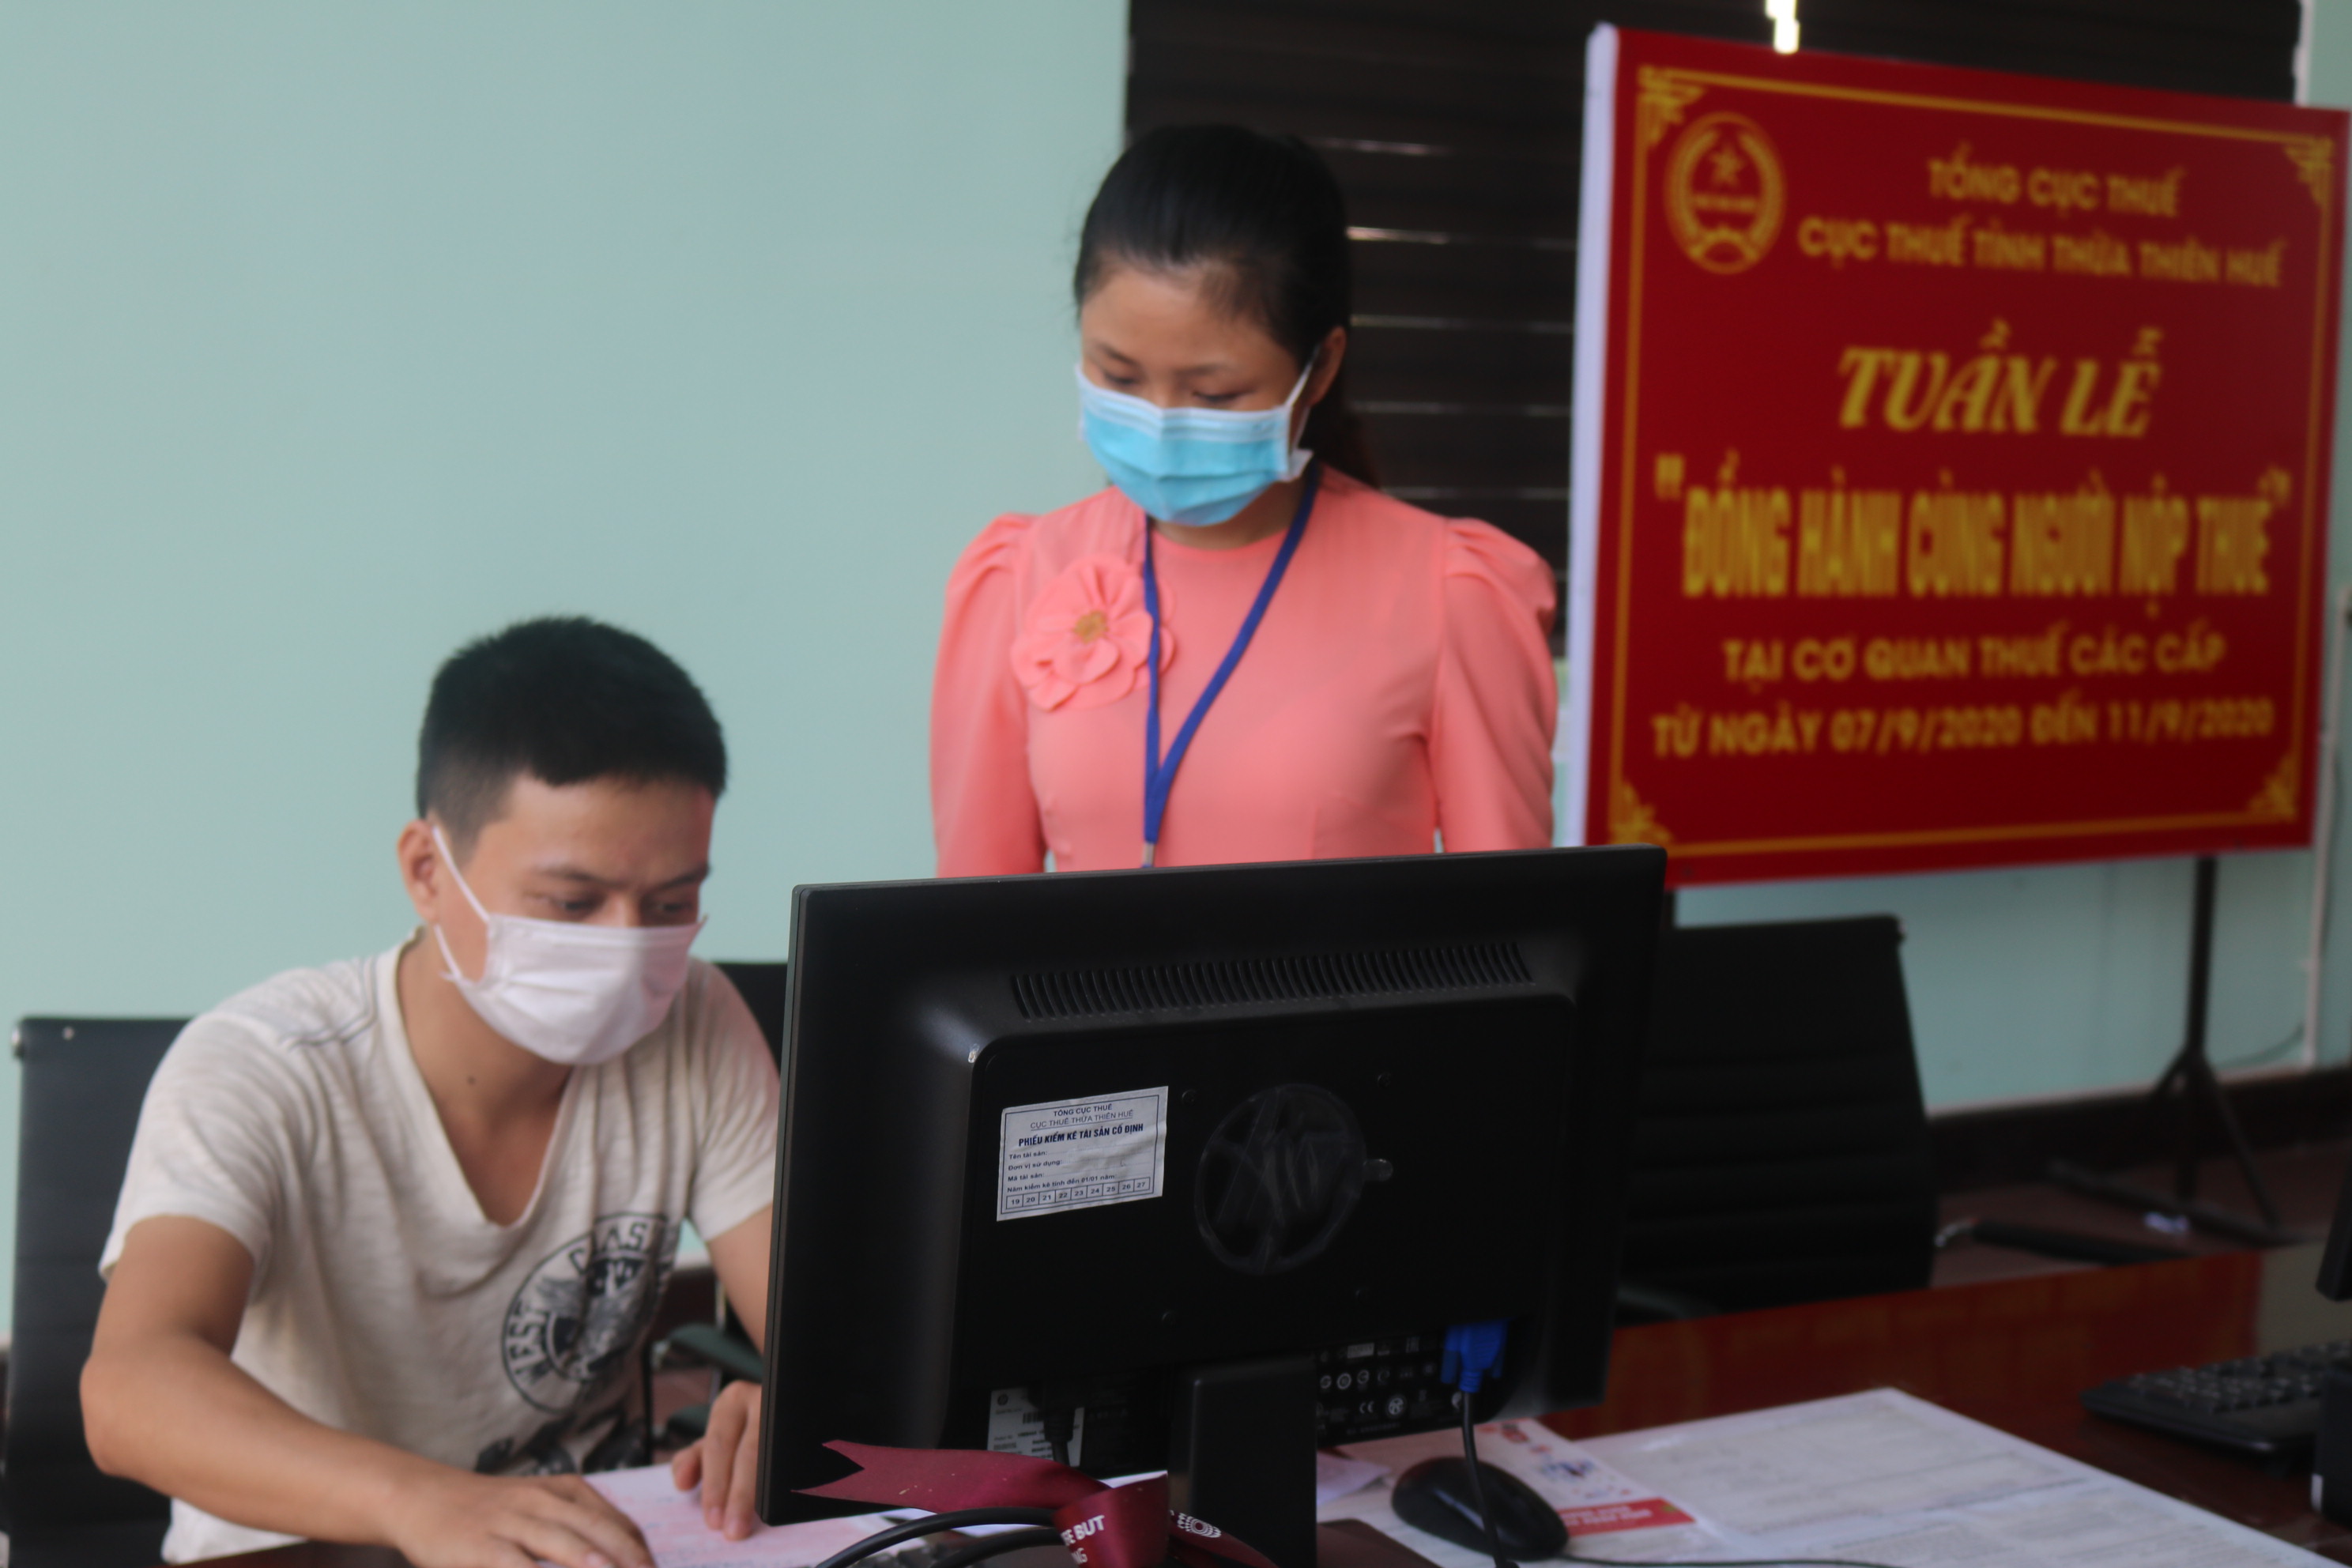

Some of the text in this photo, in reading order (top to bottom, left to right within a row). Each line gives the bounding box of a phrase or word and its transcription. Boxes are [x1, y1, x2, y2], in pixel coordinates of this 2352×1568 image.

[2029, 168, 2098, 219] CỤC
[2107, 165, 2185, 217] THUẾ
[1798, 217, 1879, 268] CỤC
[1886, 212, 1973, 268] THUẾ
[2226, 239, 2286, 288] HUẾ
[1722, 617, 2226, 694] TẠI CƠ QUAN THUẾ CÁC CẤP
[1709, 700, 1823, 756] NGÀY
[1830, 707, 2024, 753] 07/9/2020
[2031, 689, 2098, 747] ĐẾN
[2107, 698, 2275, 745] 11/9/2020
[1019, 1134, 1043, 1147] PHIẾU
[1125, 1123, 1144, 1134] ĐỊNH
[1073, 1514, 1106, 1540] BUT
